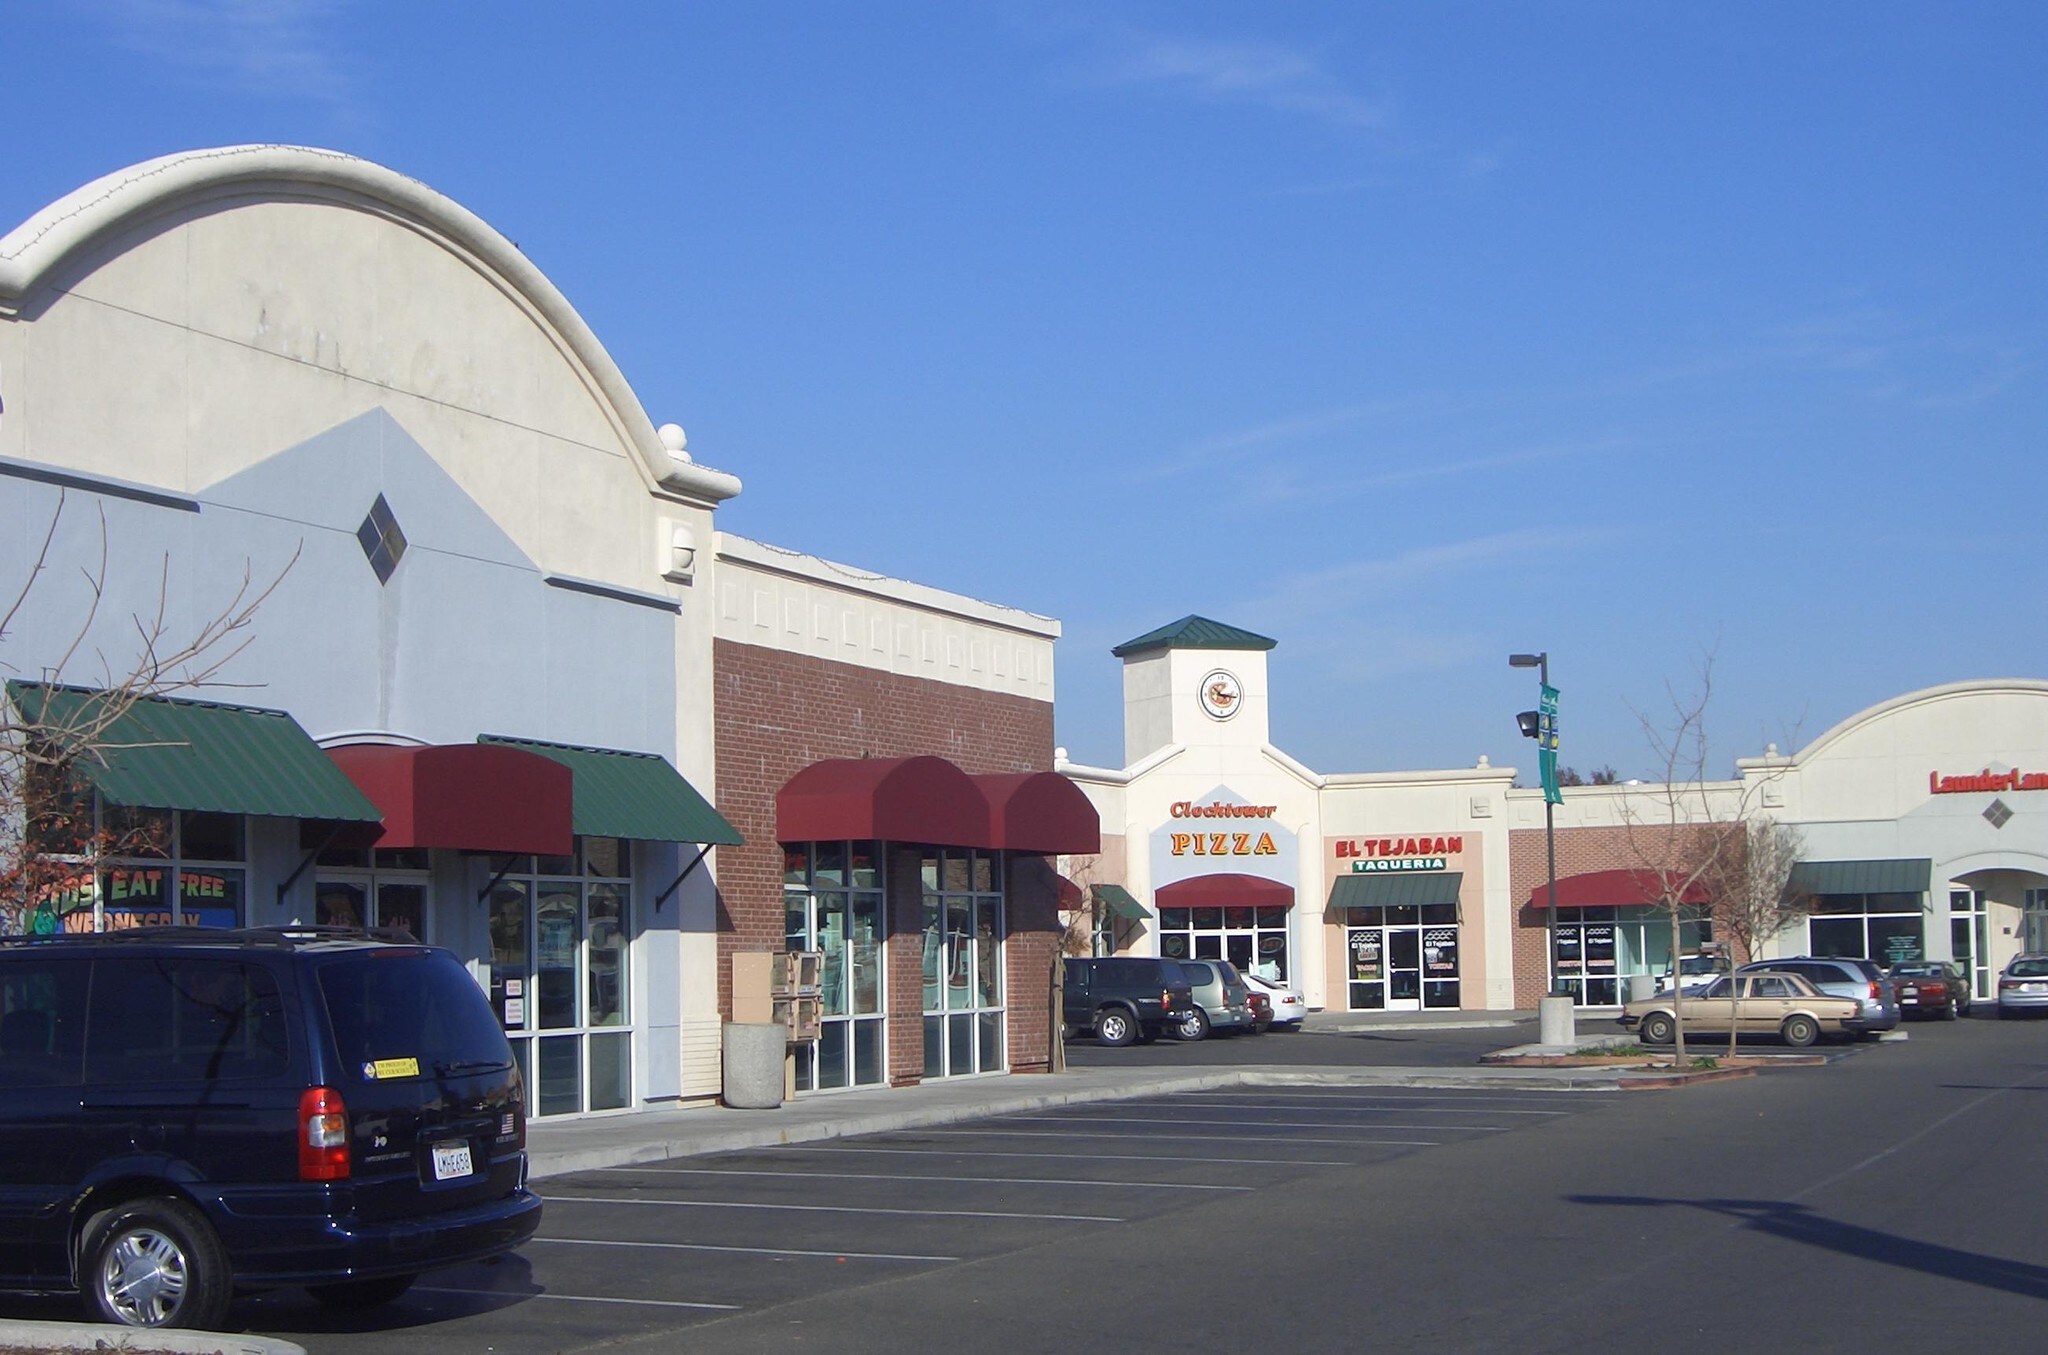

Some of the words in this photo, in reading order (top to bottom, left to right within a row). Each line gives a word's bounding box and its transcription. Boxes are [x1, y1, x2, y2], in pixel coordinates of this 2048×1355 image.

[1170, 801, 1277, 818] Clocktower
[1171, 832, 1278, 856] PIZZA
[1336, 841, 1361, 858] EL
[1364, 837, 1462, 857] TEJABAN
[1356, 859, 1444, 870] TAQUERIA
[111, 870, 162, 900] EAT
[180, 873, 225, 898] FREE
